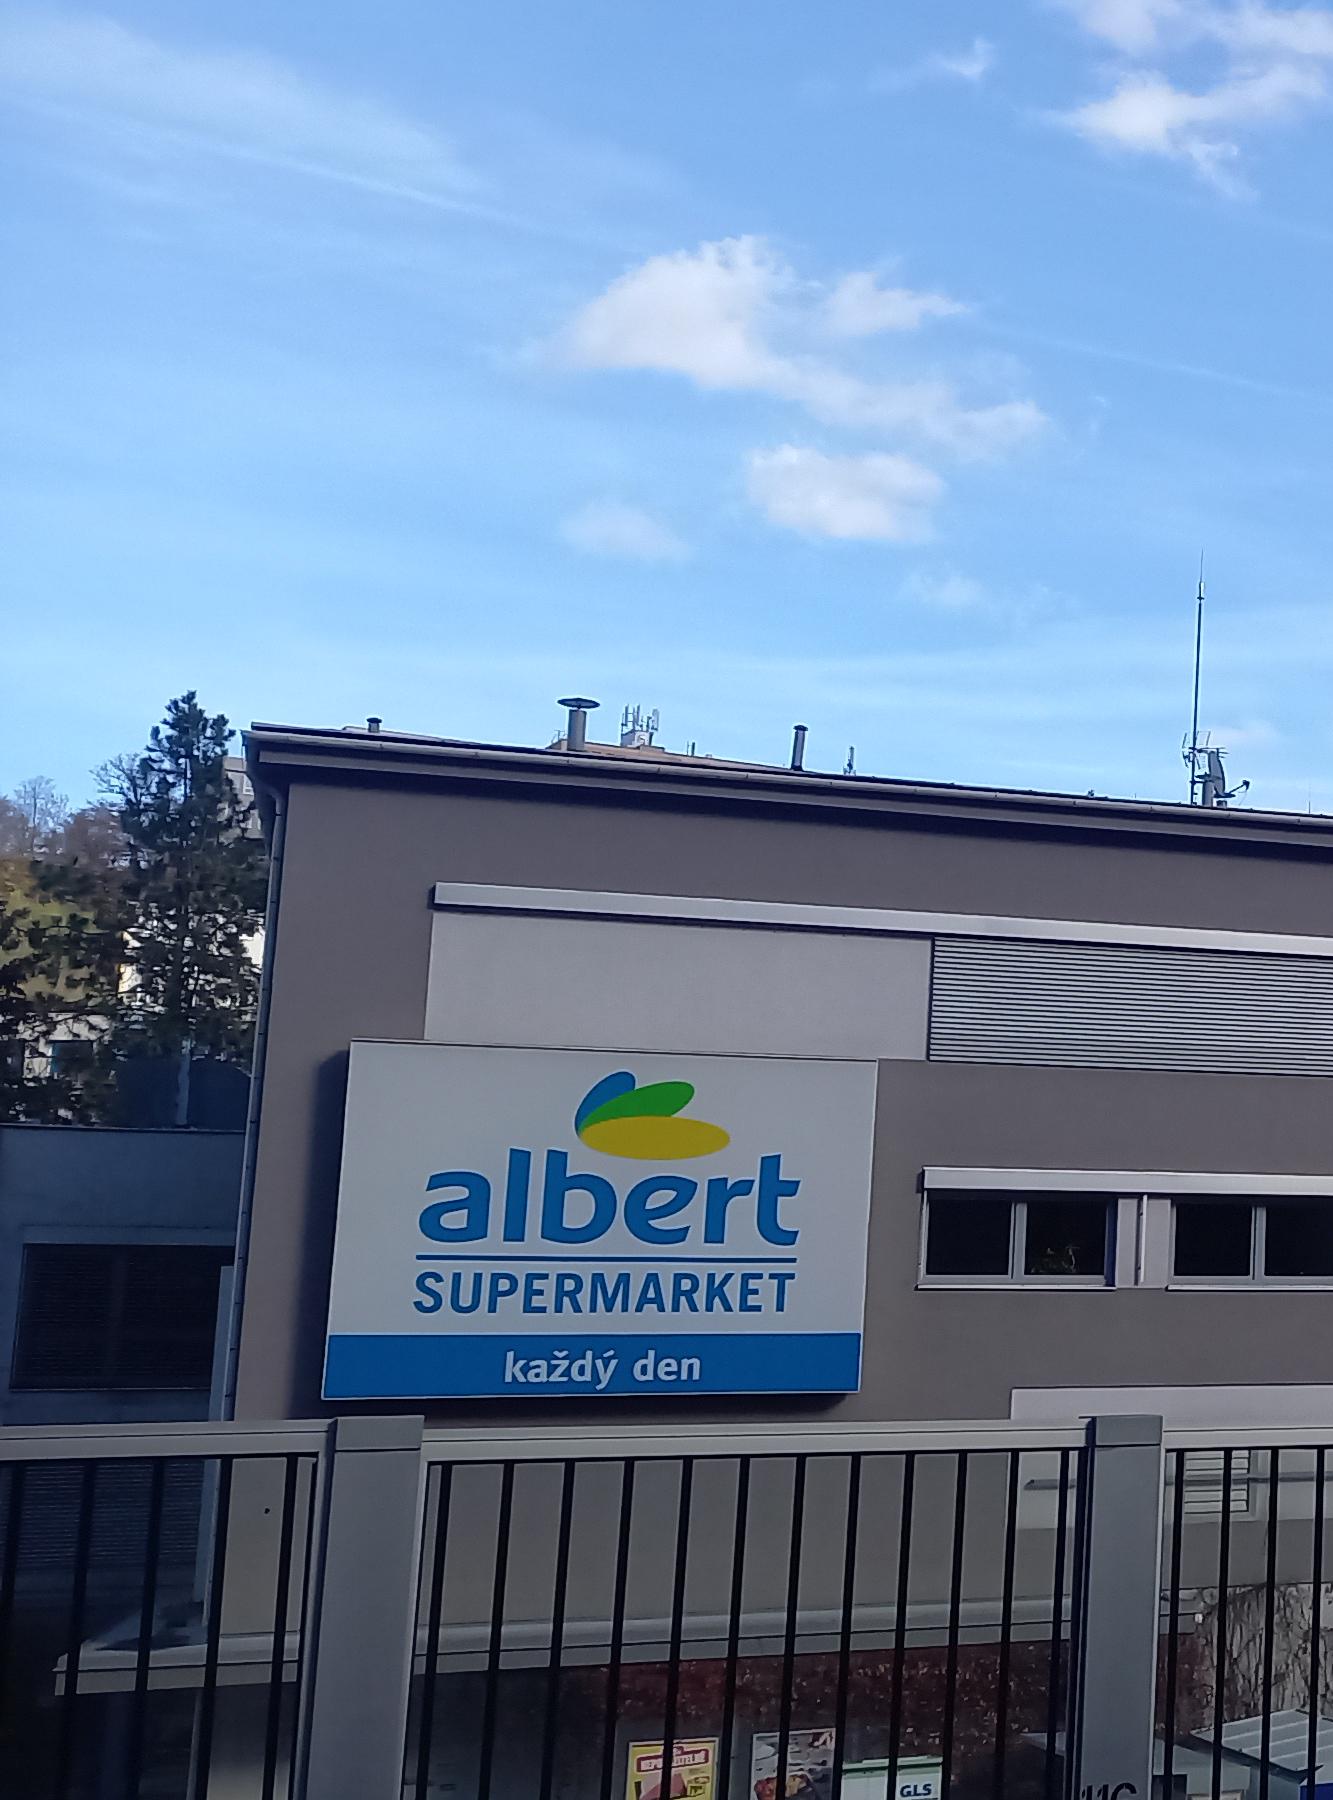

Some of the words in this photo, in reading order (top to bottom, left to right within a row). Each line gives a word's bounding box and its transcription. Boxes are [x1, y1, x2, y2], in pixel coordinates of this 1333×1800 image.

[417, 1147, 801, 1247] albert
[412, 1270, 796, 1314] SUPERMARKET
[504, 1350, 619, 1390] každý
[633, 1350, 701, 1382] den
[899, 1782, 933, 1798] GLS
